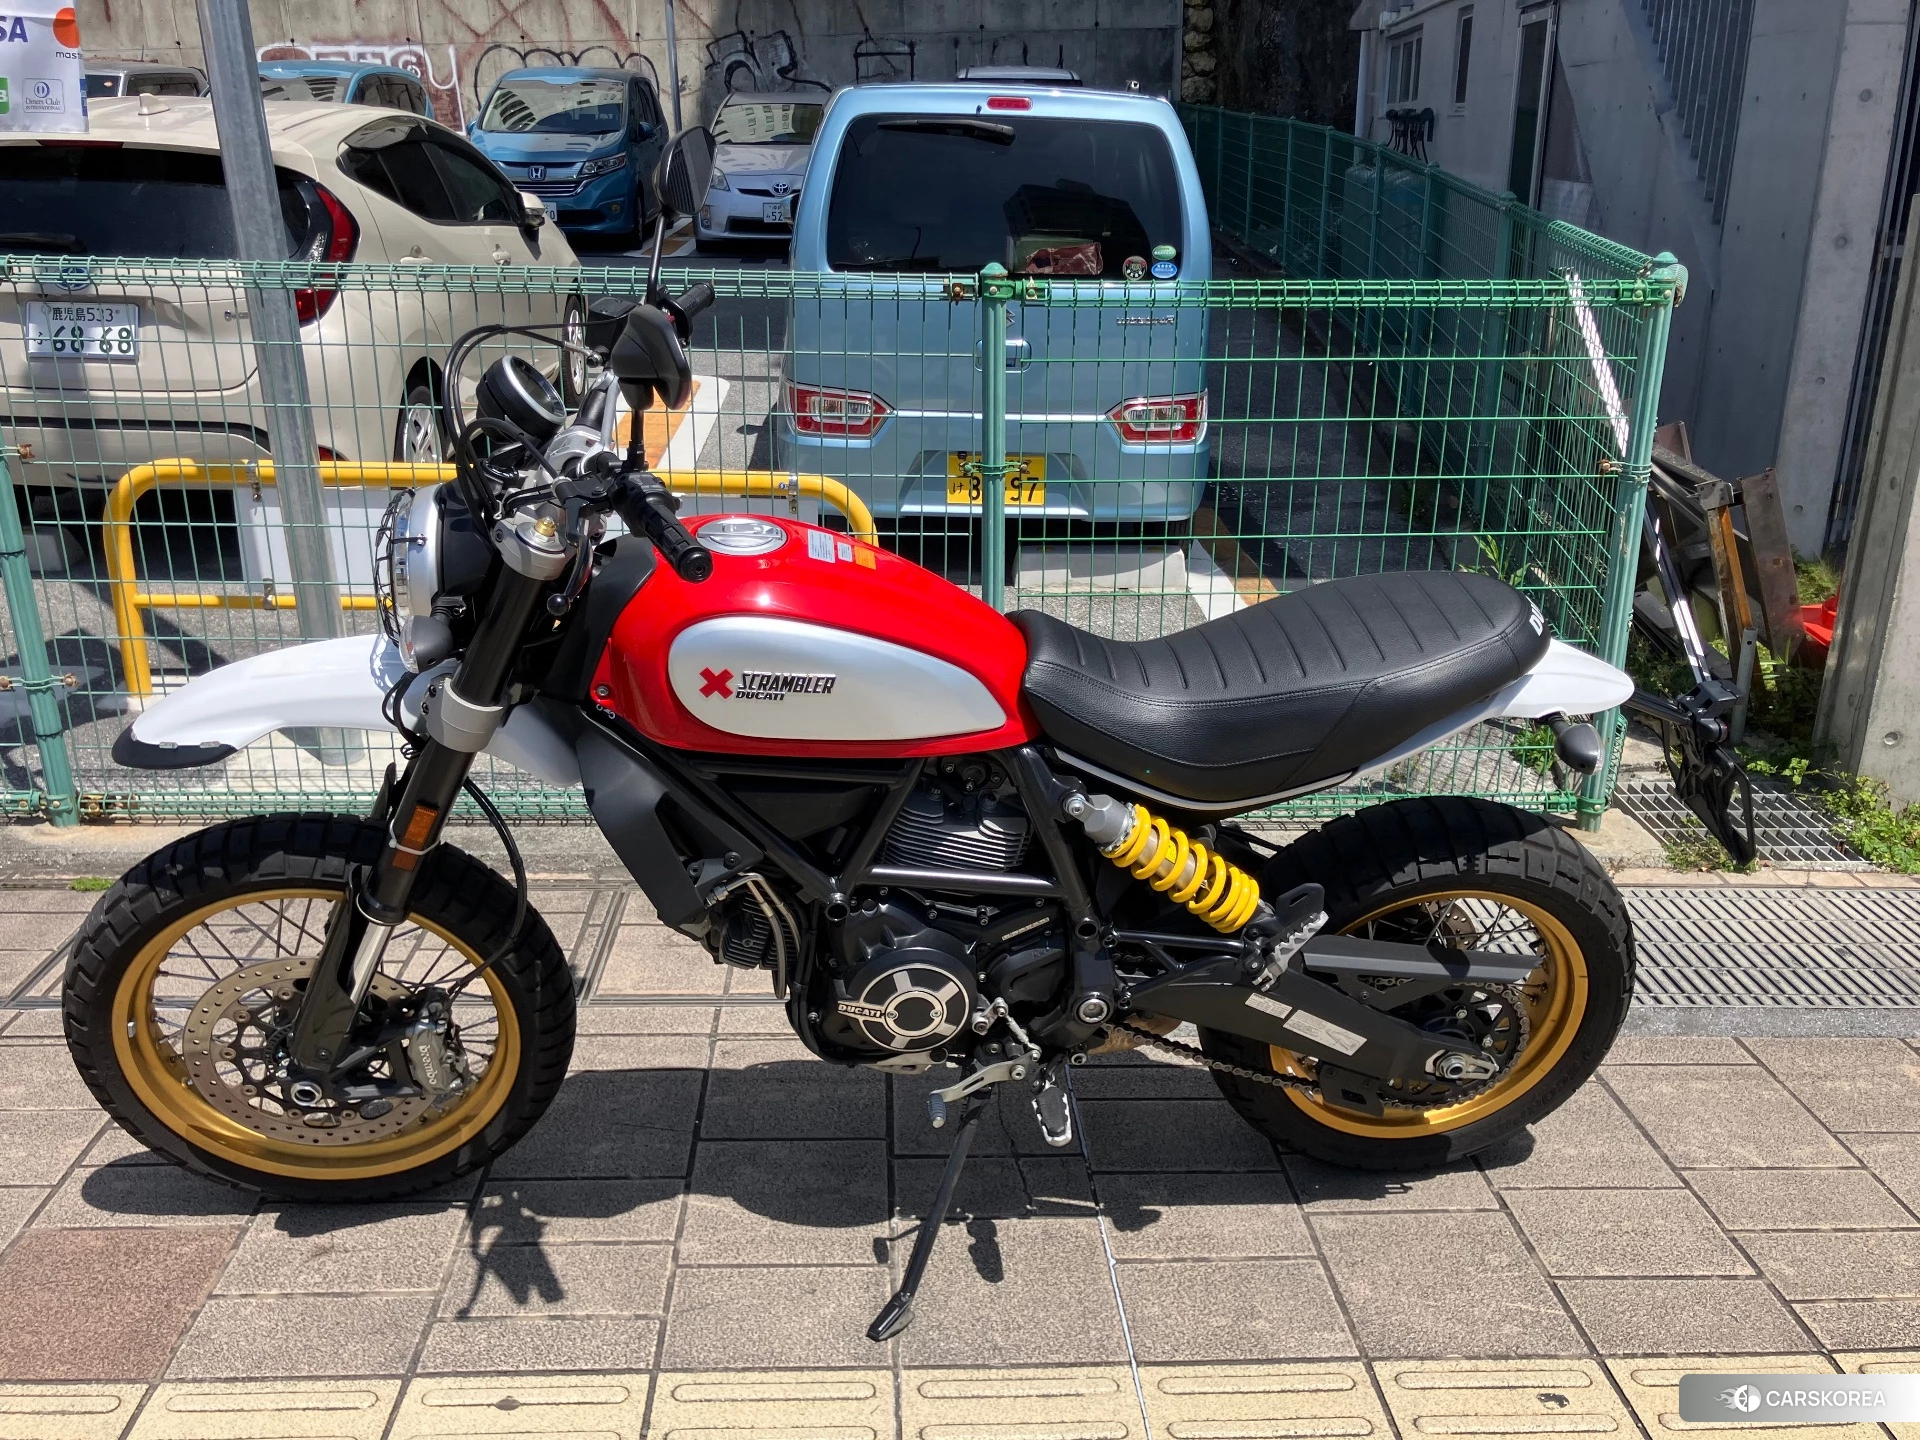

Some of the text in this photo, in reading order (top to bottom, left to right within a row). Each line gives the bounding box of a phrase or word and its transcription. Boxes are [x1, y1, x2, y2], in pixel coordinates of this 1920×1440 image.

[737, 670, 837, 695] SCRAMBLER
[735, 690, 785, 701] DUCATI
[837, 1003, 883, 1019] DUCATI
